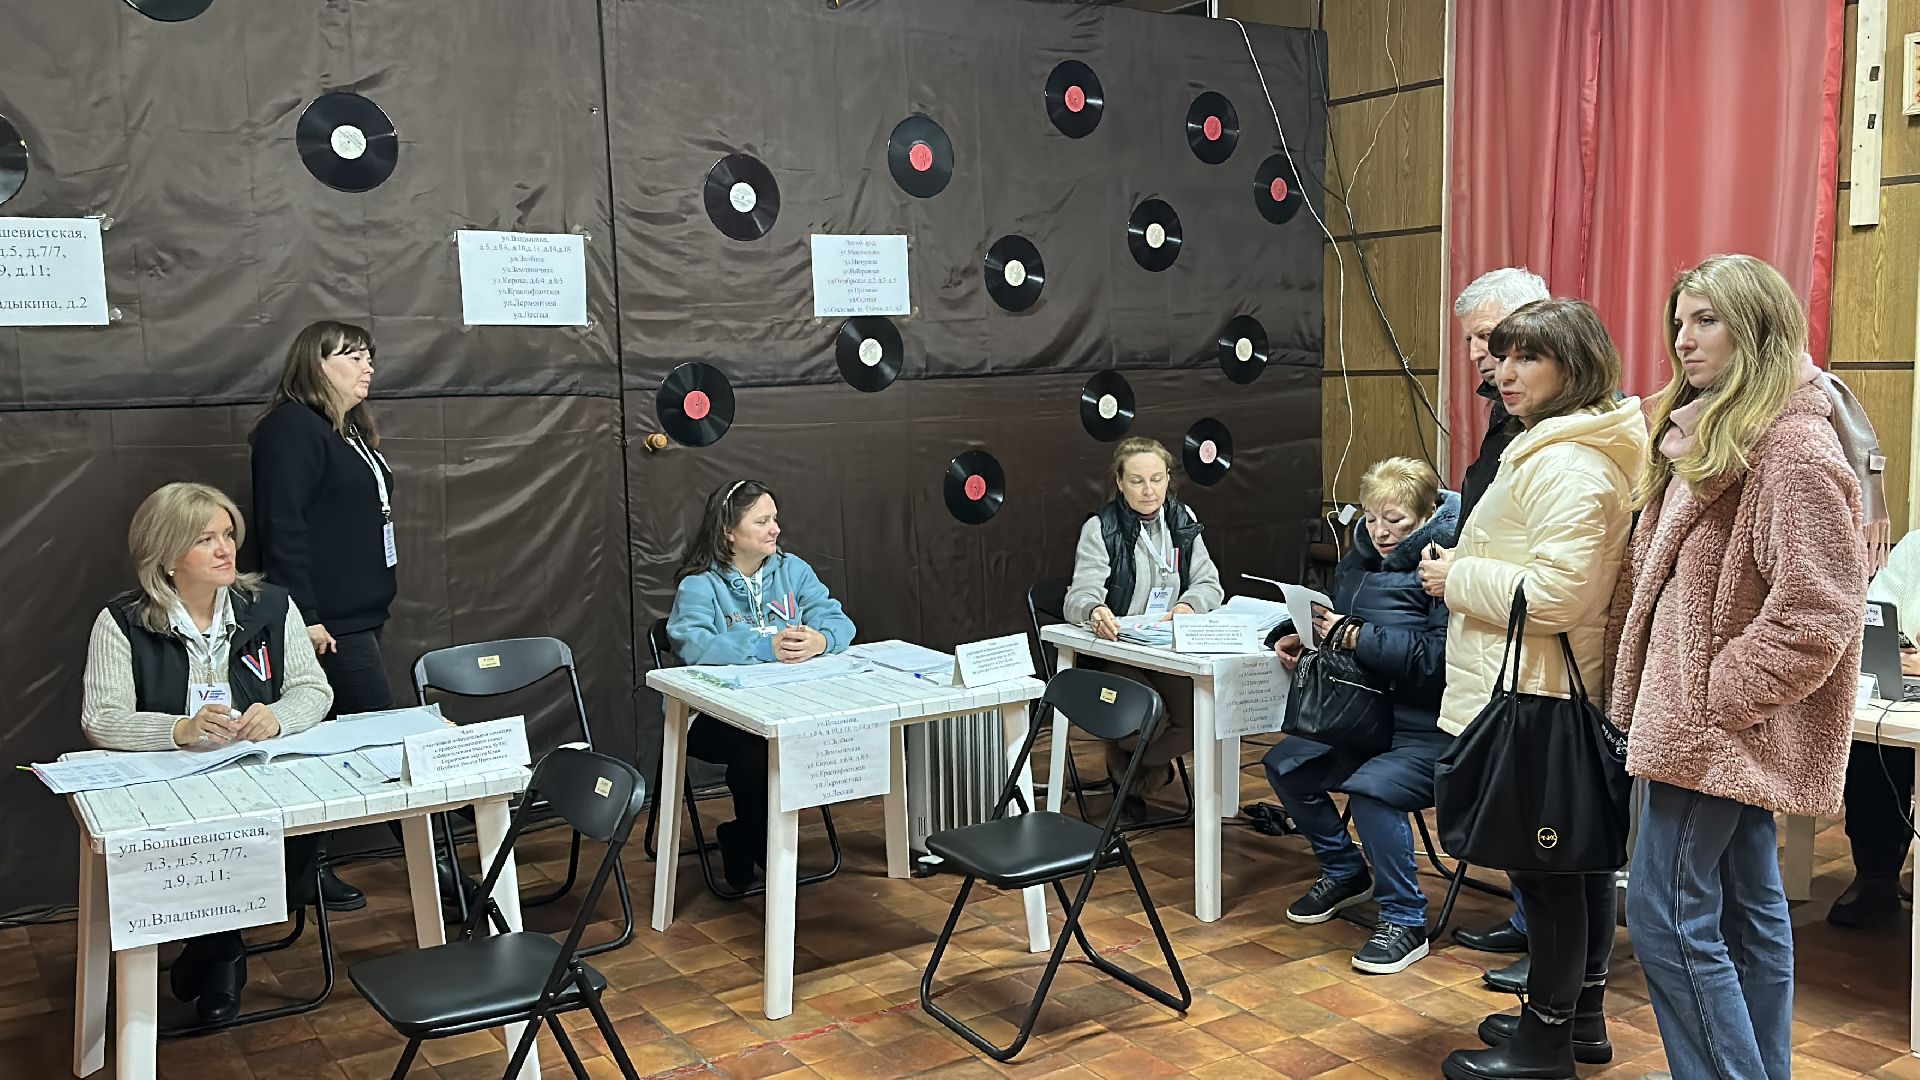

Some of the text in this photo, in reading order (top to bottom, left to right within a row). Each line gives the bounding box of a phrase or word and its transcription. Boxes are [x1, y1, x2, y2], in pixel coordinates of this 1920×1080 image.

[27, 246, 66, 258] д.7/7,
[16, 265, 51, 278] д.11;
[66, 296, 88, 310] д.2
[118, 826, 270, 858] ул.Большевистская,
[144, 847, 248, 873] д.3, д.5, д.7/7,
[163, 869, 231, 891] д.9, д.11;
[128, 896, 266, 933] ул.Владыкина, д.2
